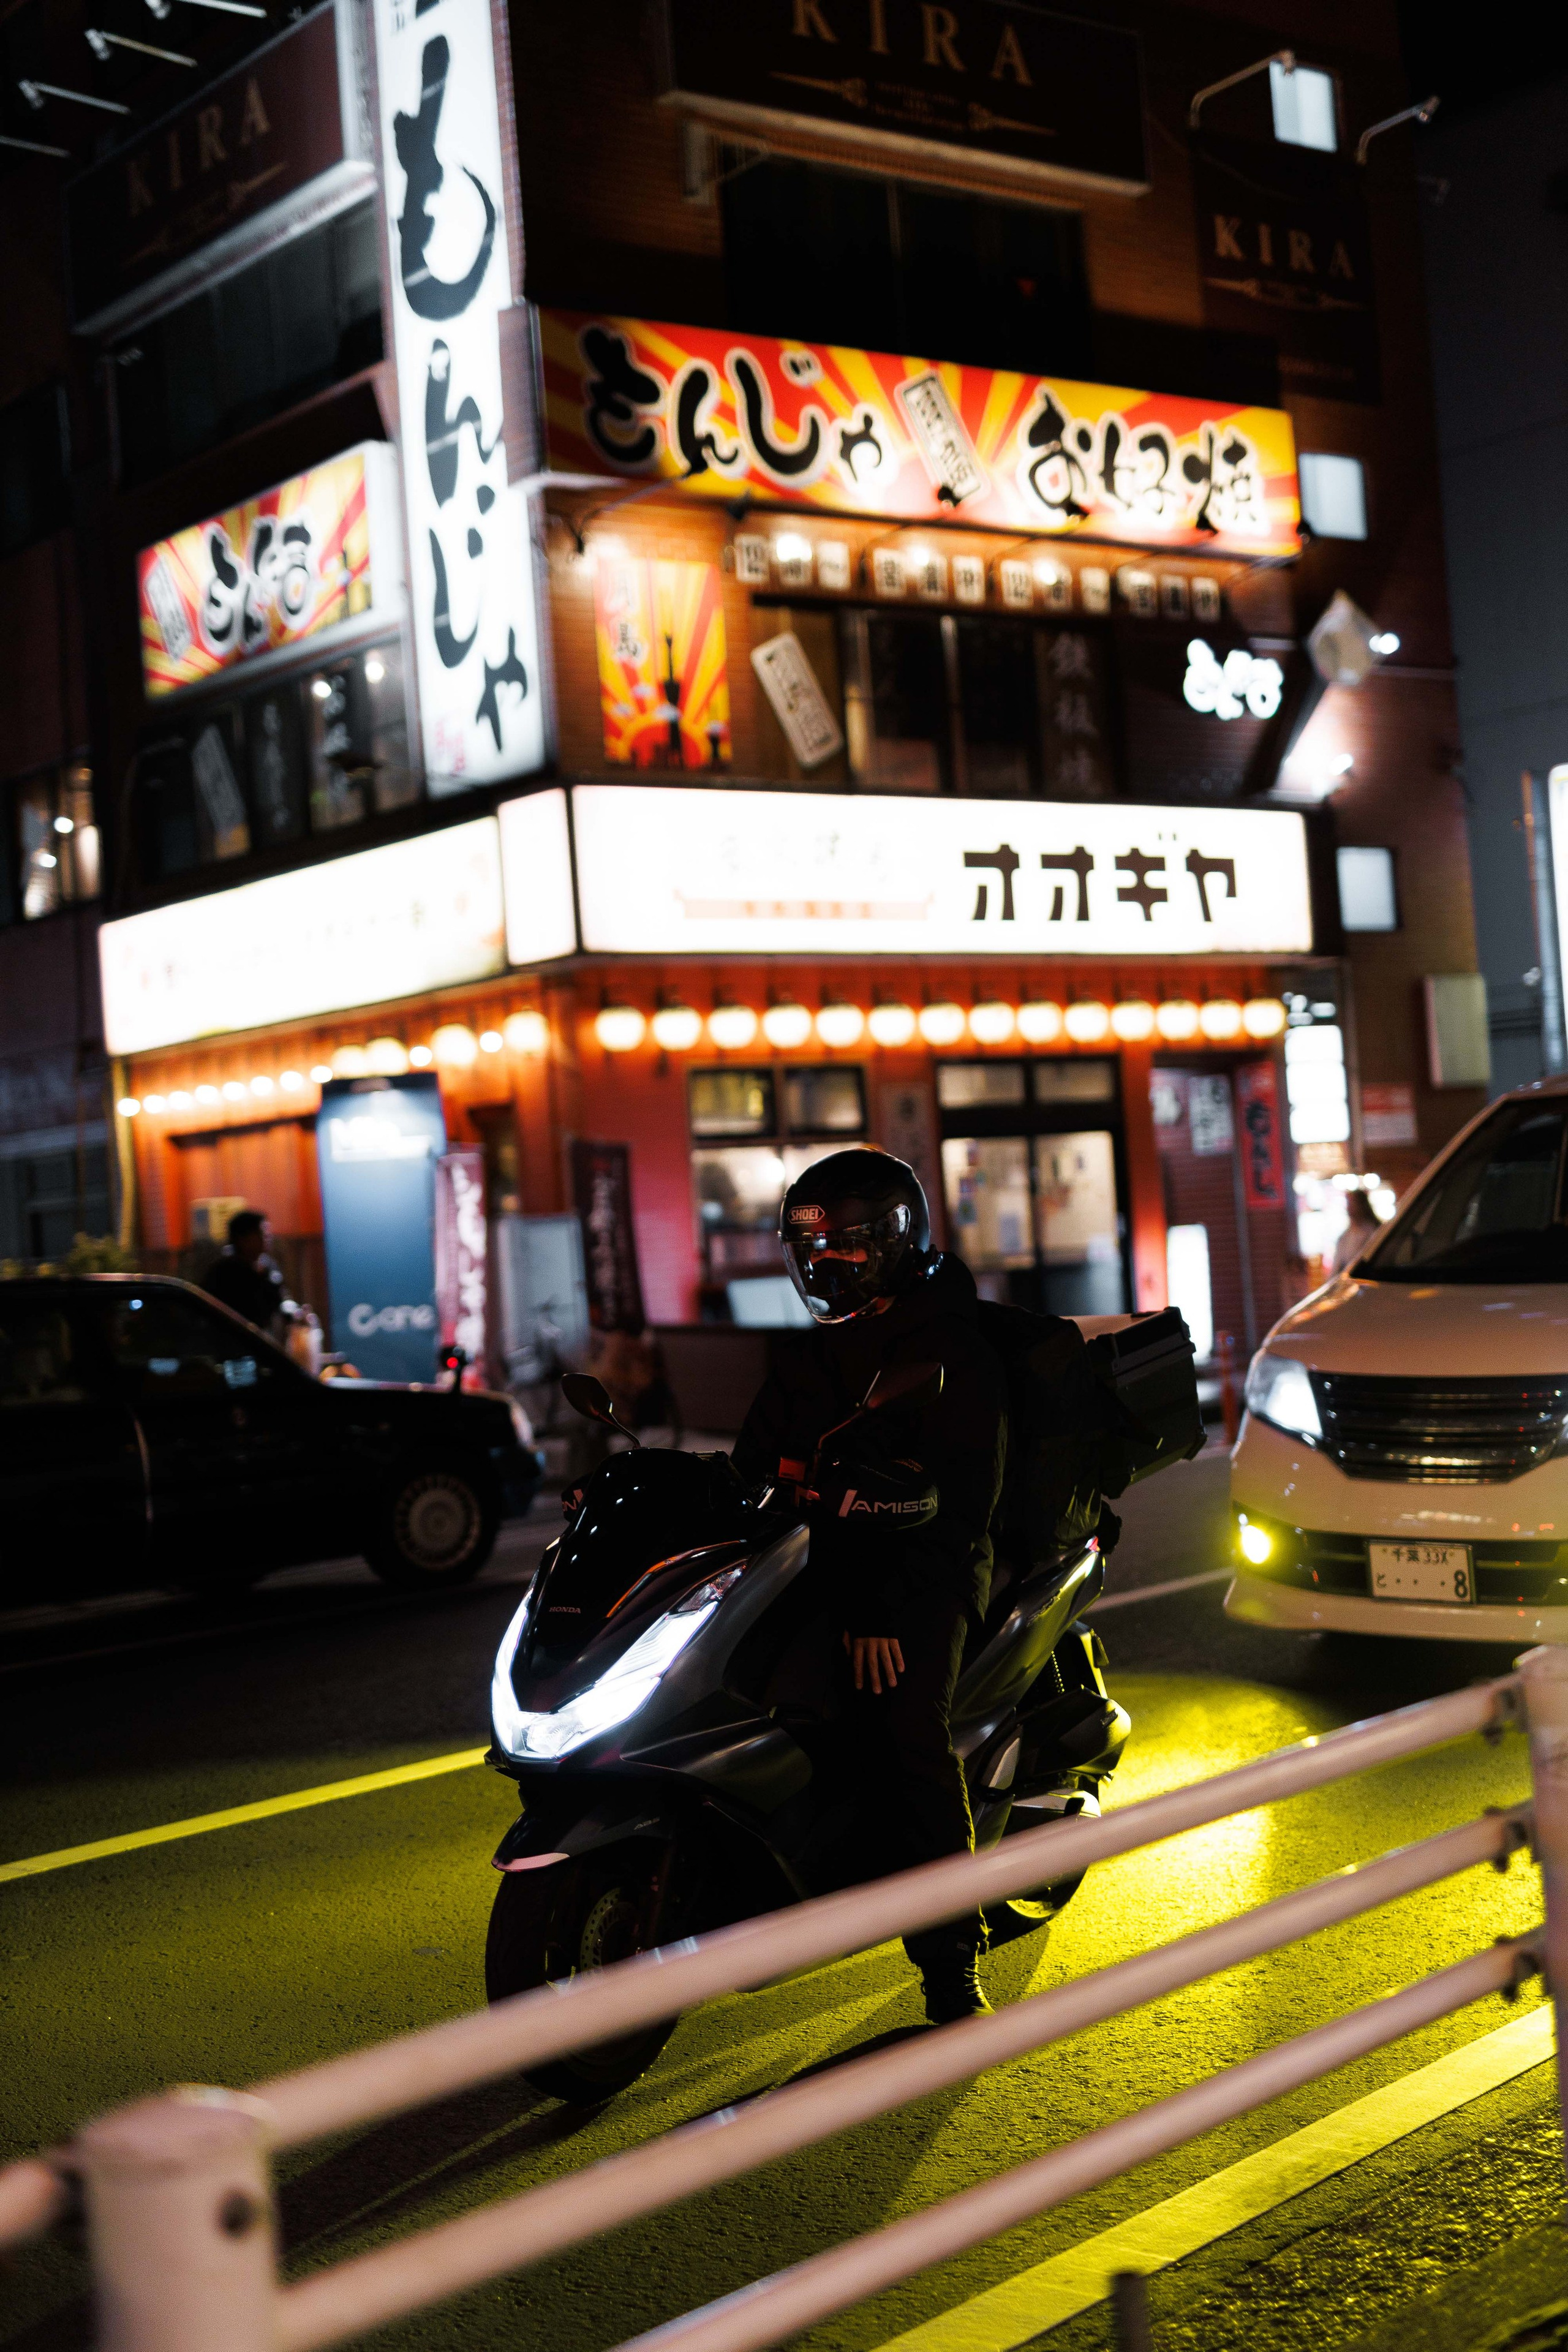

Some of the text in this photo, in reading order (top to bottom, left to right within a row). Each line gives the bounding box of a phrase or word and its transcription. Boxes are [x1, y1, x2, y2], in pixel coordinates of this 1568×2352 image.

[791, 0, 1035, 87] KIRA
[1212, 213, 1356, 281] KIRA
[964, 831, 1237, 922] オオギヤ
[791, 1208, 819, 1221] SHOEI
